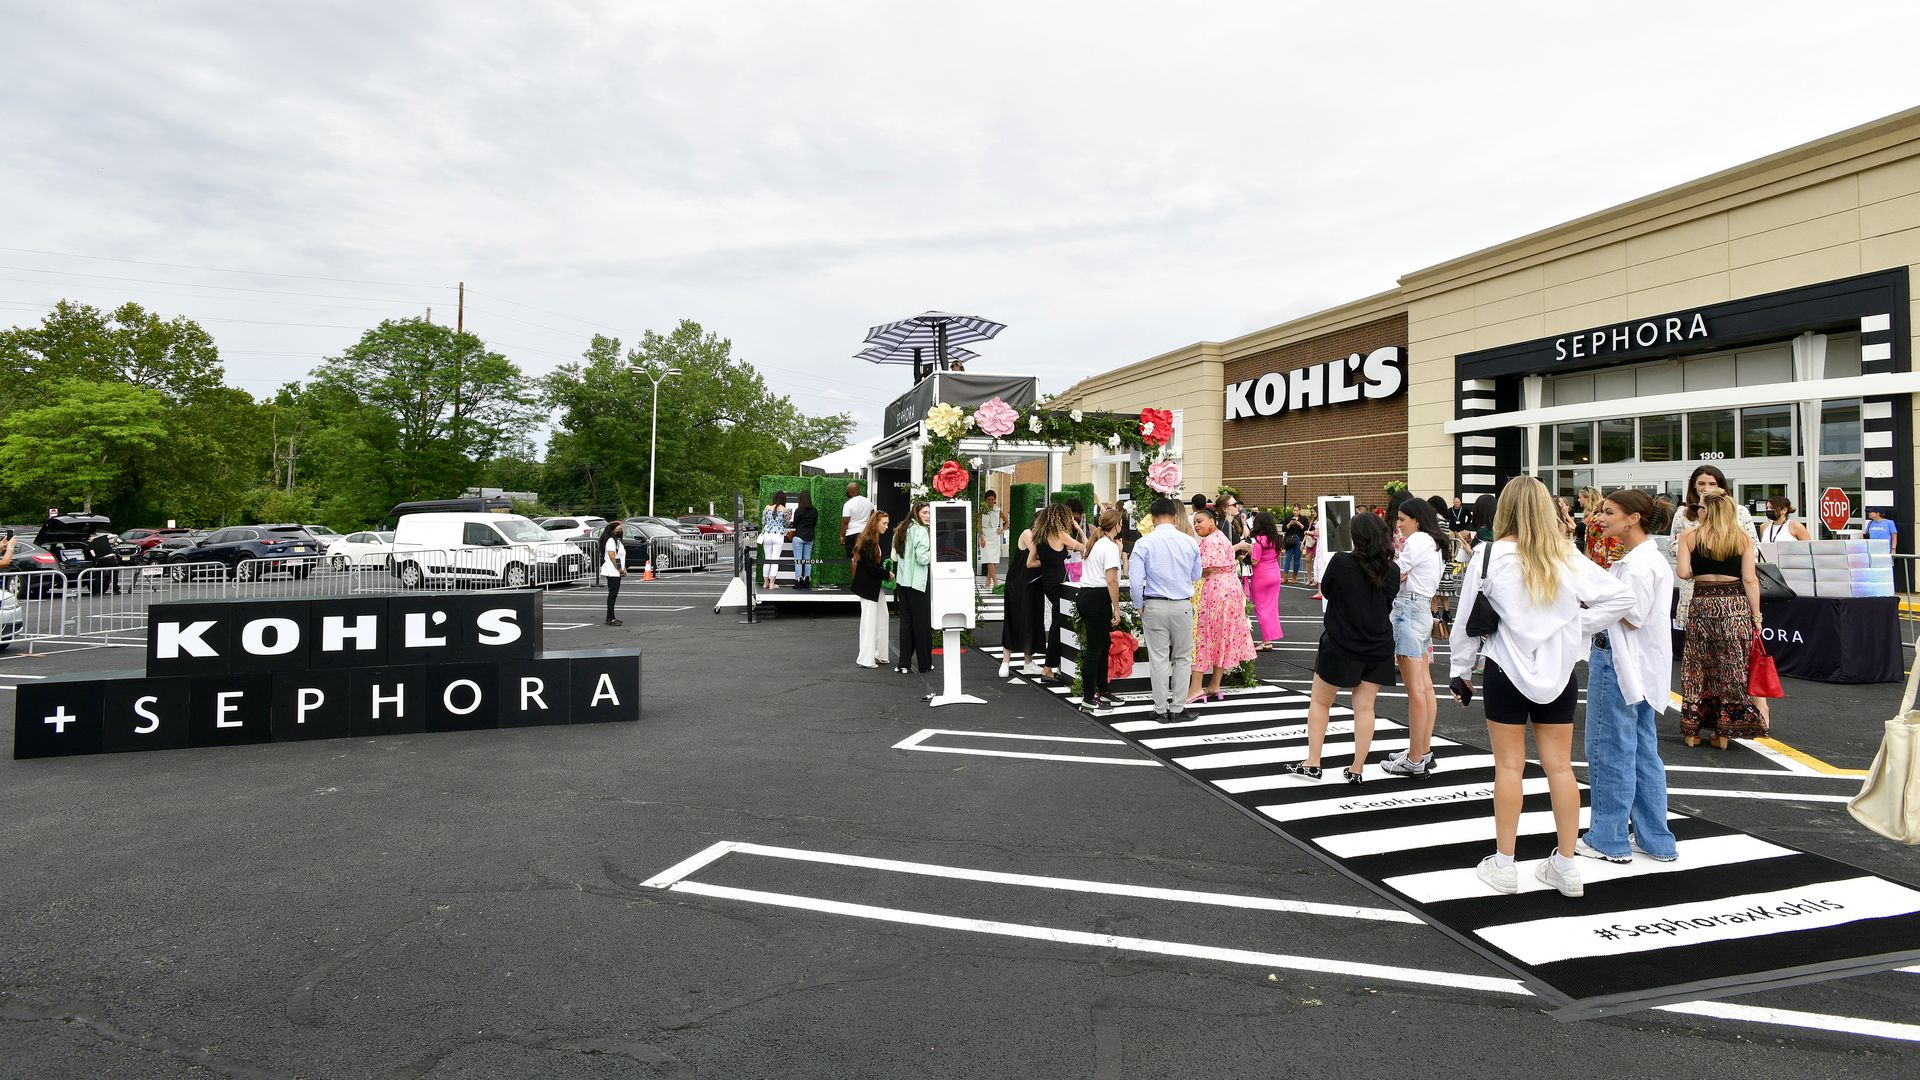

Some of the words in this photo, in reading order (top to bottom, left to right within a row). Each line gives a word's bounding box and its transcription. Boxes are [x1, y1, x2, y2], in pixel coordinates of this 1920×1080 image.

[1555, 313, 1708, 361] SEPHORA
[1225, 346, 1402, 420] KOHL'S
[1699, 451, 1724, 460] 1300
[1823, 501, 1848, 518] STOP
[156, 608, 522, 659] KOHL'S
[133, 673, 621, 734] SEPHORA
[1593, 898, 1845, 942] #SephoraxKohls
